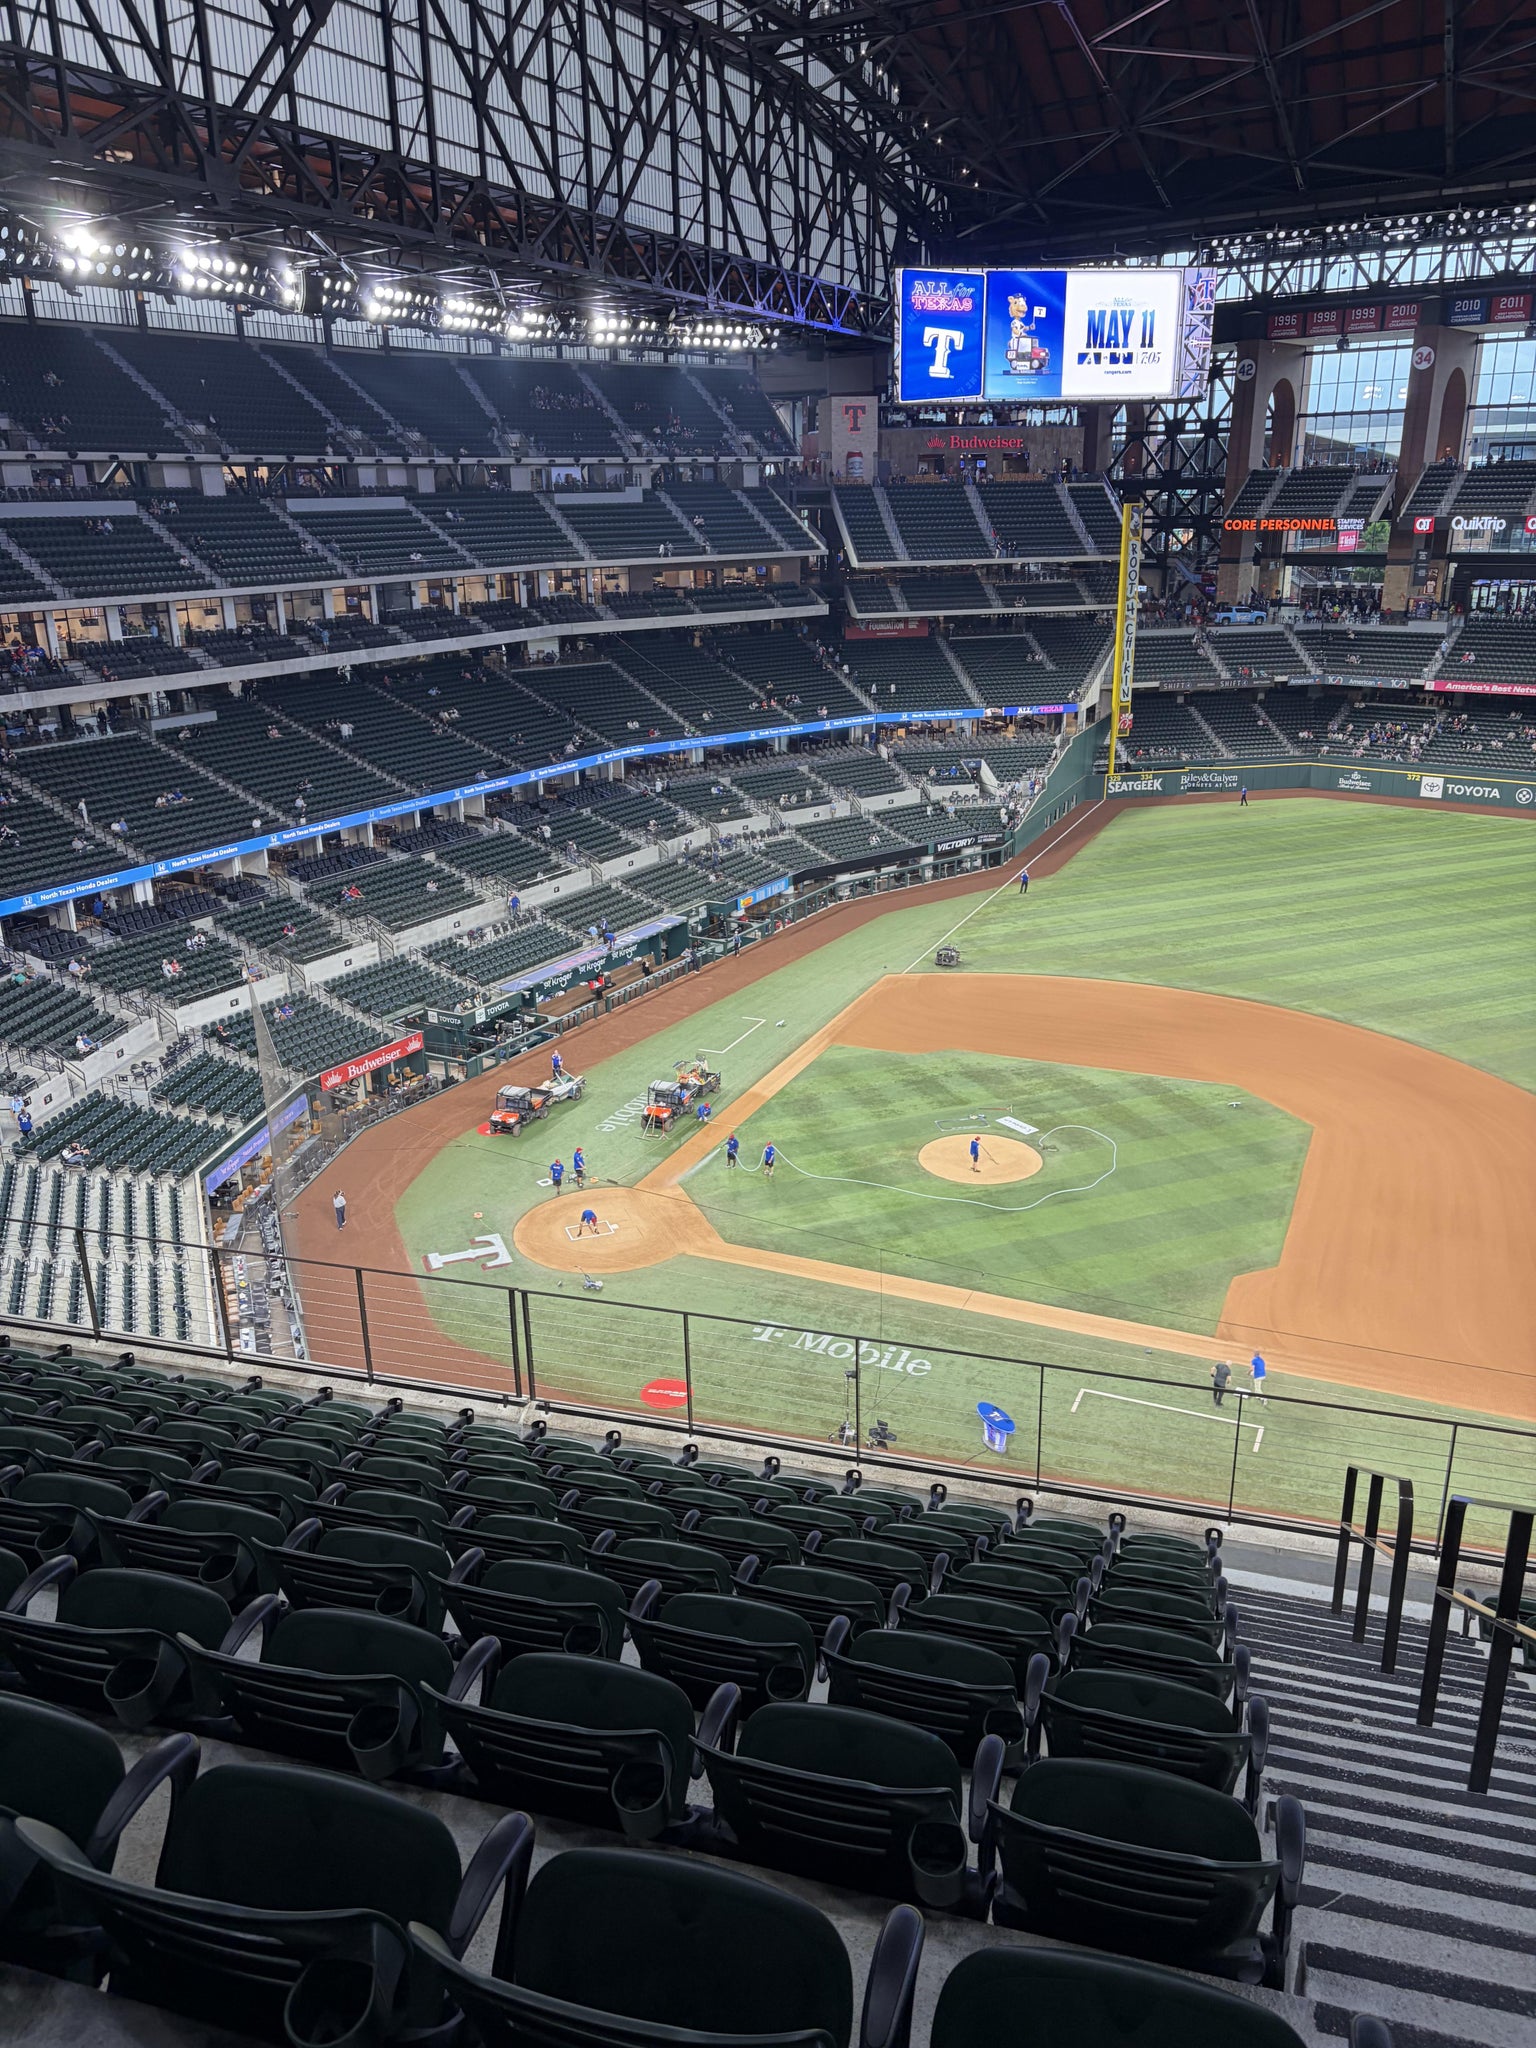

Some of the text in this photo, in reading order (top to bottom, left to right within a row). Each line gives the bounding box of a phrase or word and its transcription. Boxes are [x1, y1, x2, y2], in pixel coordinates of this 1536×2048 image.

[911, 280, 976, 299] ALL for
[911, 295, 973, 312] TEXAS
[1454, 299, 1481, 312] 2010
[1499, 296, 1524, 309] 2011
[1313, 311, 1337, 323] 1998
[1351, 307, 1376, 320] 1999
[1392, 304, 1418, 317] 2010
[1274, 314, 1297, 327] 1996
[1085, 309, 1156, 349] MAY 11
[923, 326, 965, 379] T
[1415, 351, 1431, 365] 34
[1238, 363, 1254, 377] 42
[842, 404, 866, 434] T
[1224, 519, 1336, 531] CORE PERSONNEL
[1415, 518, 1432, 531] QT
[1451, 515, 1507, 533] QuikTrip
[1127, 543, 1138, 596] ROOT
[1445, 682, 1491, 692] America's
[1491, 685, 1513, 693] Best
[1338, 777, 1372, 787] Budweiser
[1406, 773, 1421, 782] 372
[1107, 778, 1163, 794] SEATGEEK
[1446, 784, 1501, 799] TOYOTA
[283, 821, 341, 840] North Texas Honda Dealers
[937, 837, 972, 852] VICTORY
[171, 846, 238, 868] North Texas Honda Dealers
[40, 876, 119, 901] North Texas Honda Dealers
[619, 944, 638, 959] Kroger
[586, 958, 607, 973] Kroger
[552, 972, 573, 988] Kroger
[486, 1001, 510, 1016] TOYOTA
[439, 1015, 461, 1025] TOYOTA
[347, 1048, 402, 1078] Budweiser
[421, 1233, 513, 1273] T
[788, 1331, 932, 1377] Mobile
